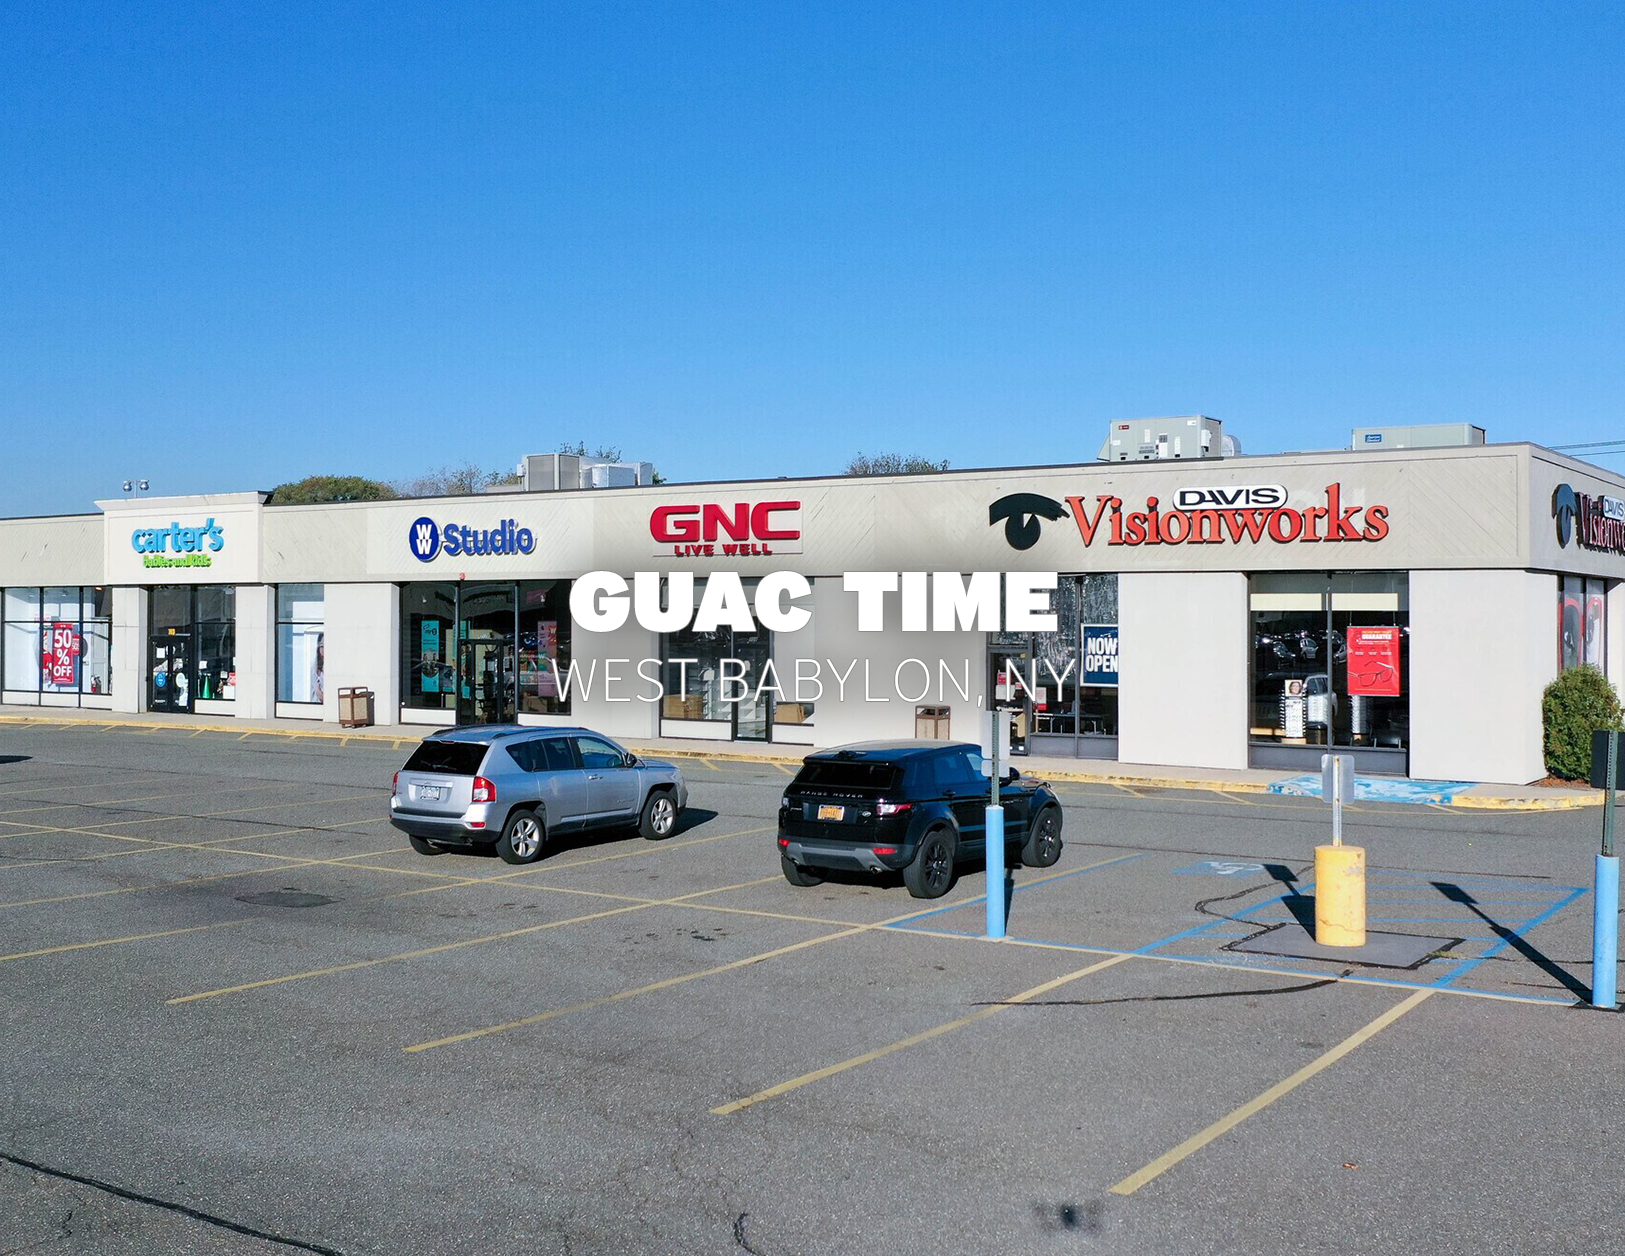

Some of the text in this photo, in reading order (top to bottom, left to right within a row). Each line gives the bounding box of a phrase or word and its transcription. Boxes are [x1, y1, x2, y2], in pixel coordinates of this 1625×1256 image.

[1180, 488, 1280, 506] DAVIS
[1065, 483, 1390, 547] Visionworks
[1604, 498, 1625, 517] DAVIS
[649, 500, 802, 542] GNC
[131, 518, 225, 553] carter's
[442, 519, 535, 555] Studio
[674, 543, 773, 557] LIVE WELL
[54, 629, 72, 648] 50
[1087, 637, 1118, 655] NOW
[56, 648, 70, 665] %
[1086, 655, 1118, 672] OPEN
[53, 665, 72, 677] OFF
